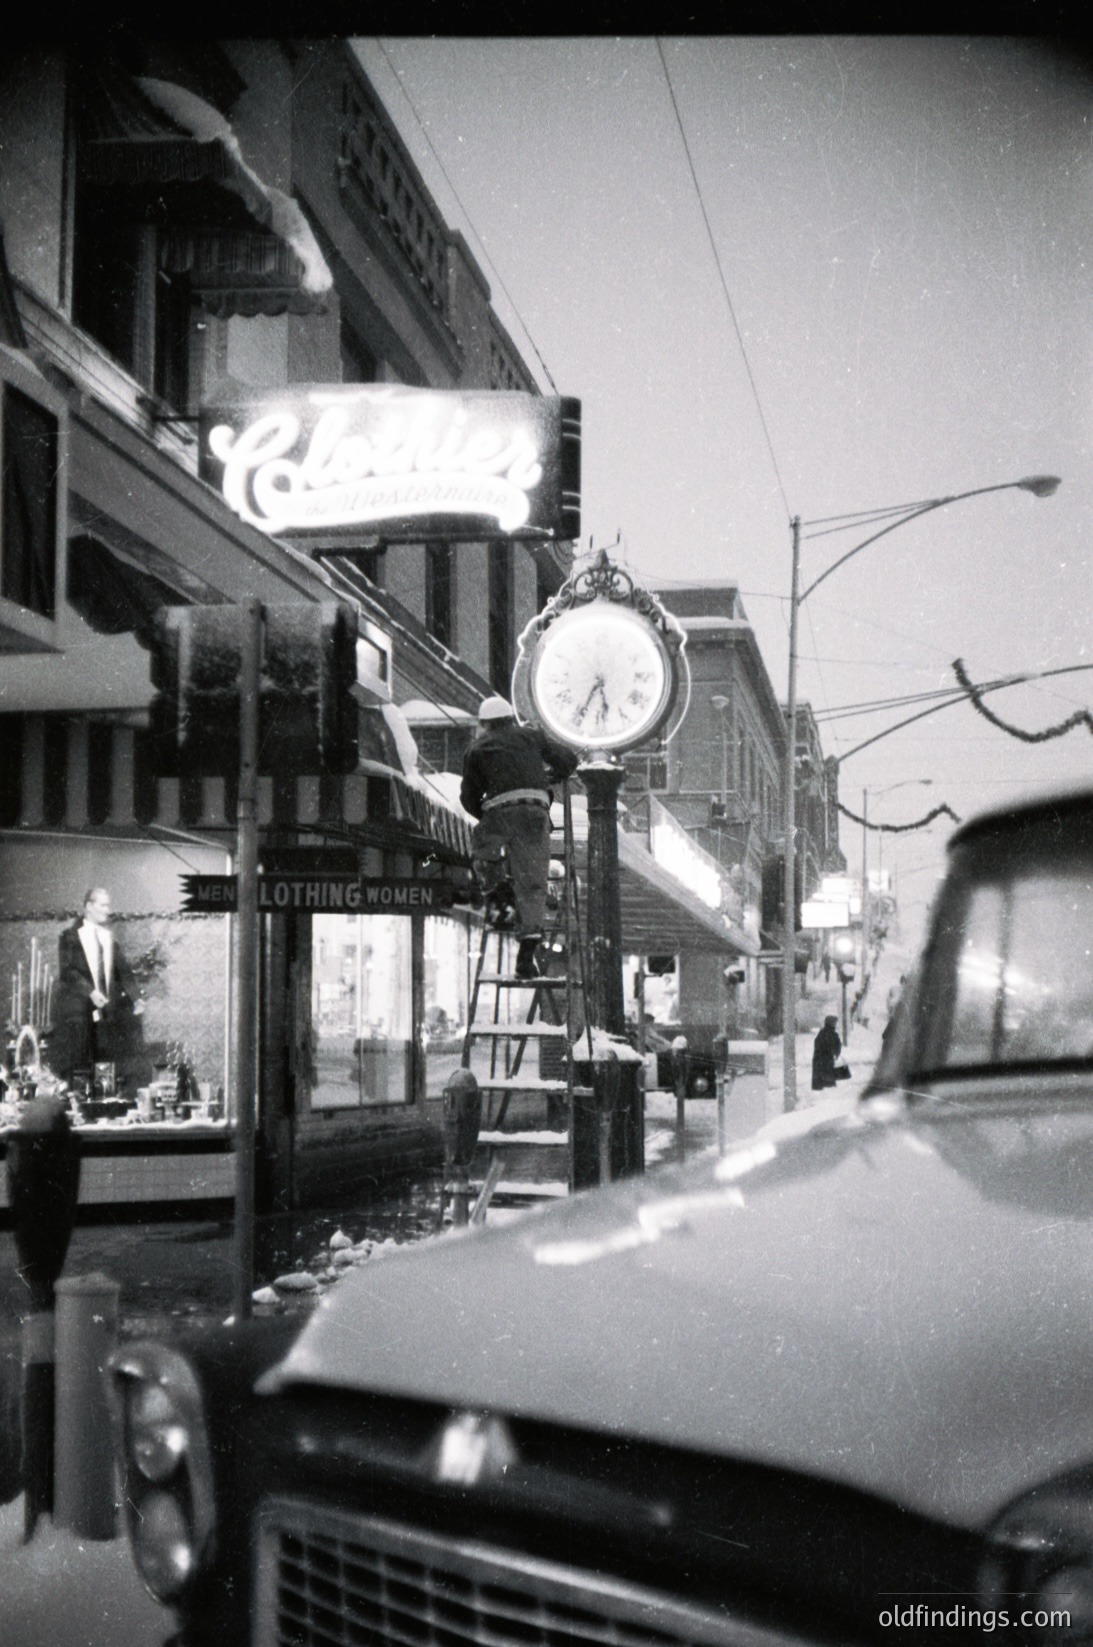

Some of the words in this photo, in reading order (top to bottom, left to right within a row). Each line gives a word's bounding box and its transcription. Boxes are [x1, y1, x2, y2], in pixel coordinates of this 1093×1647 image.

[210, 398, 542, 532] Clothier
[336, 483, 508, 512] Westernaire
[197, 885, 235, 902] MEN
[259, 881, 361, 908] LOTHING
[366, 886, 433, 905] WOMEN
